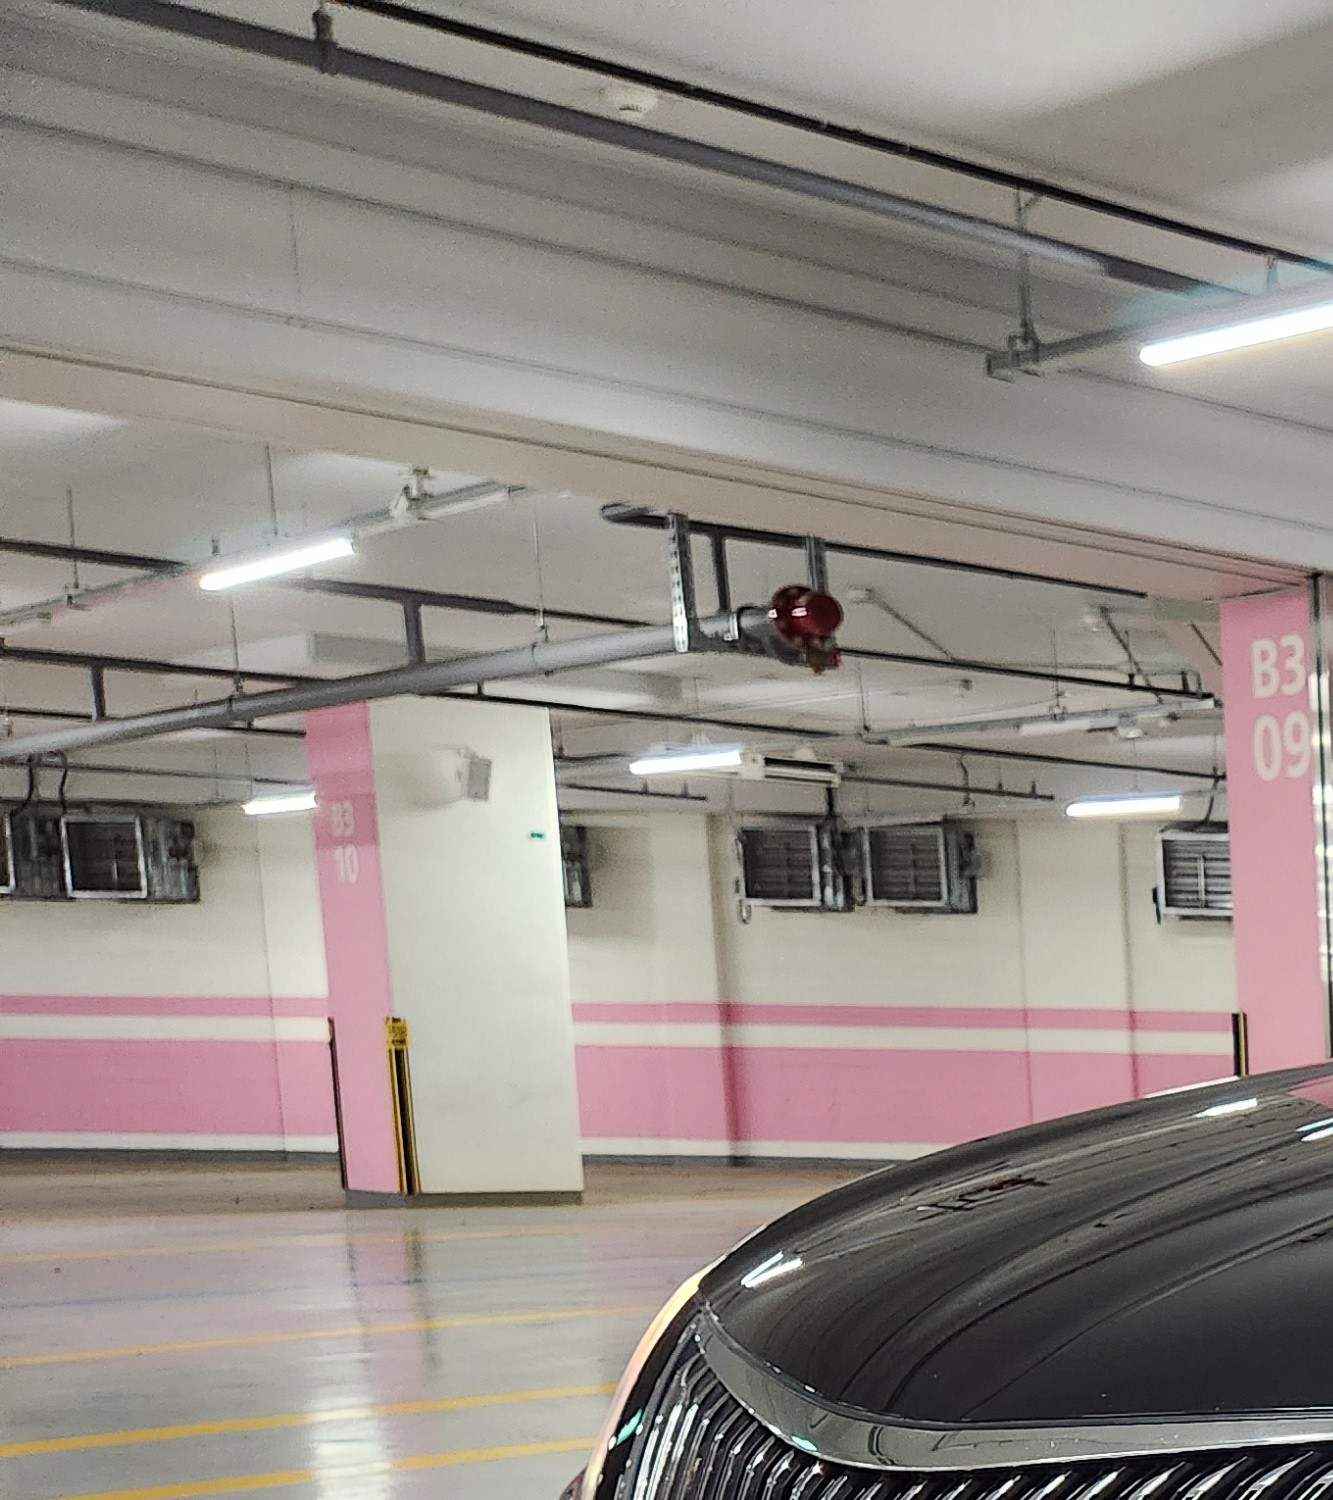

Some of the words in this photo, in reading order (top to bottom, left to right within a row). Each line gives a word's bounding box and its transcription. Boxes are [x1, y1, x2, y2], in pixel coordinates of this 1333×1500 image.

[1252, 634, 1306, 698] B3
[1254, 709, 1311, 781] 09
[334, 843, 361, 883] 10
